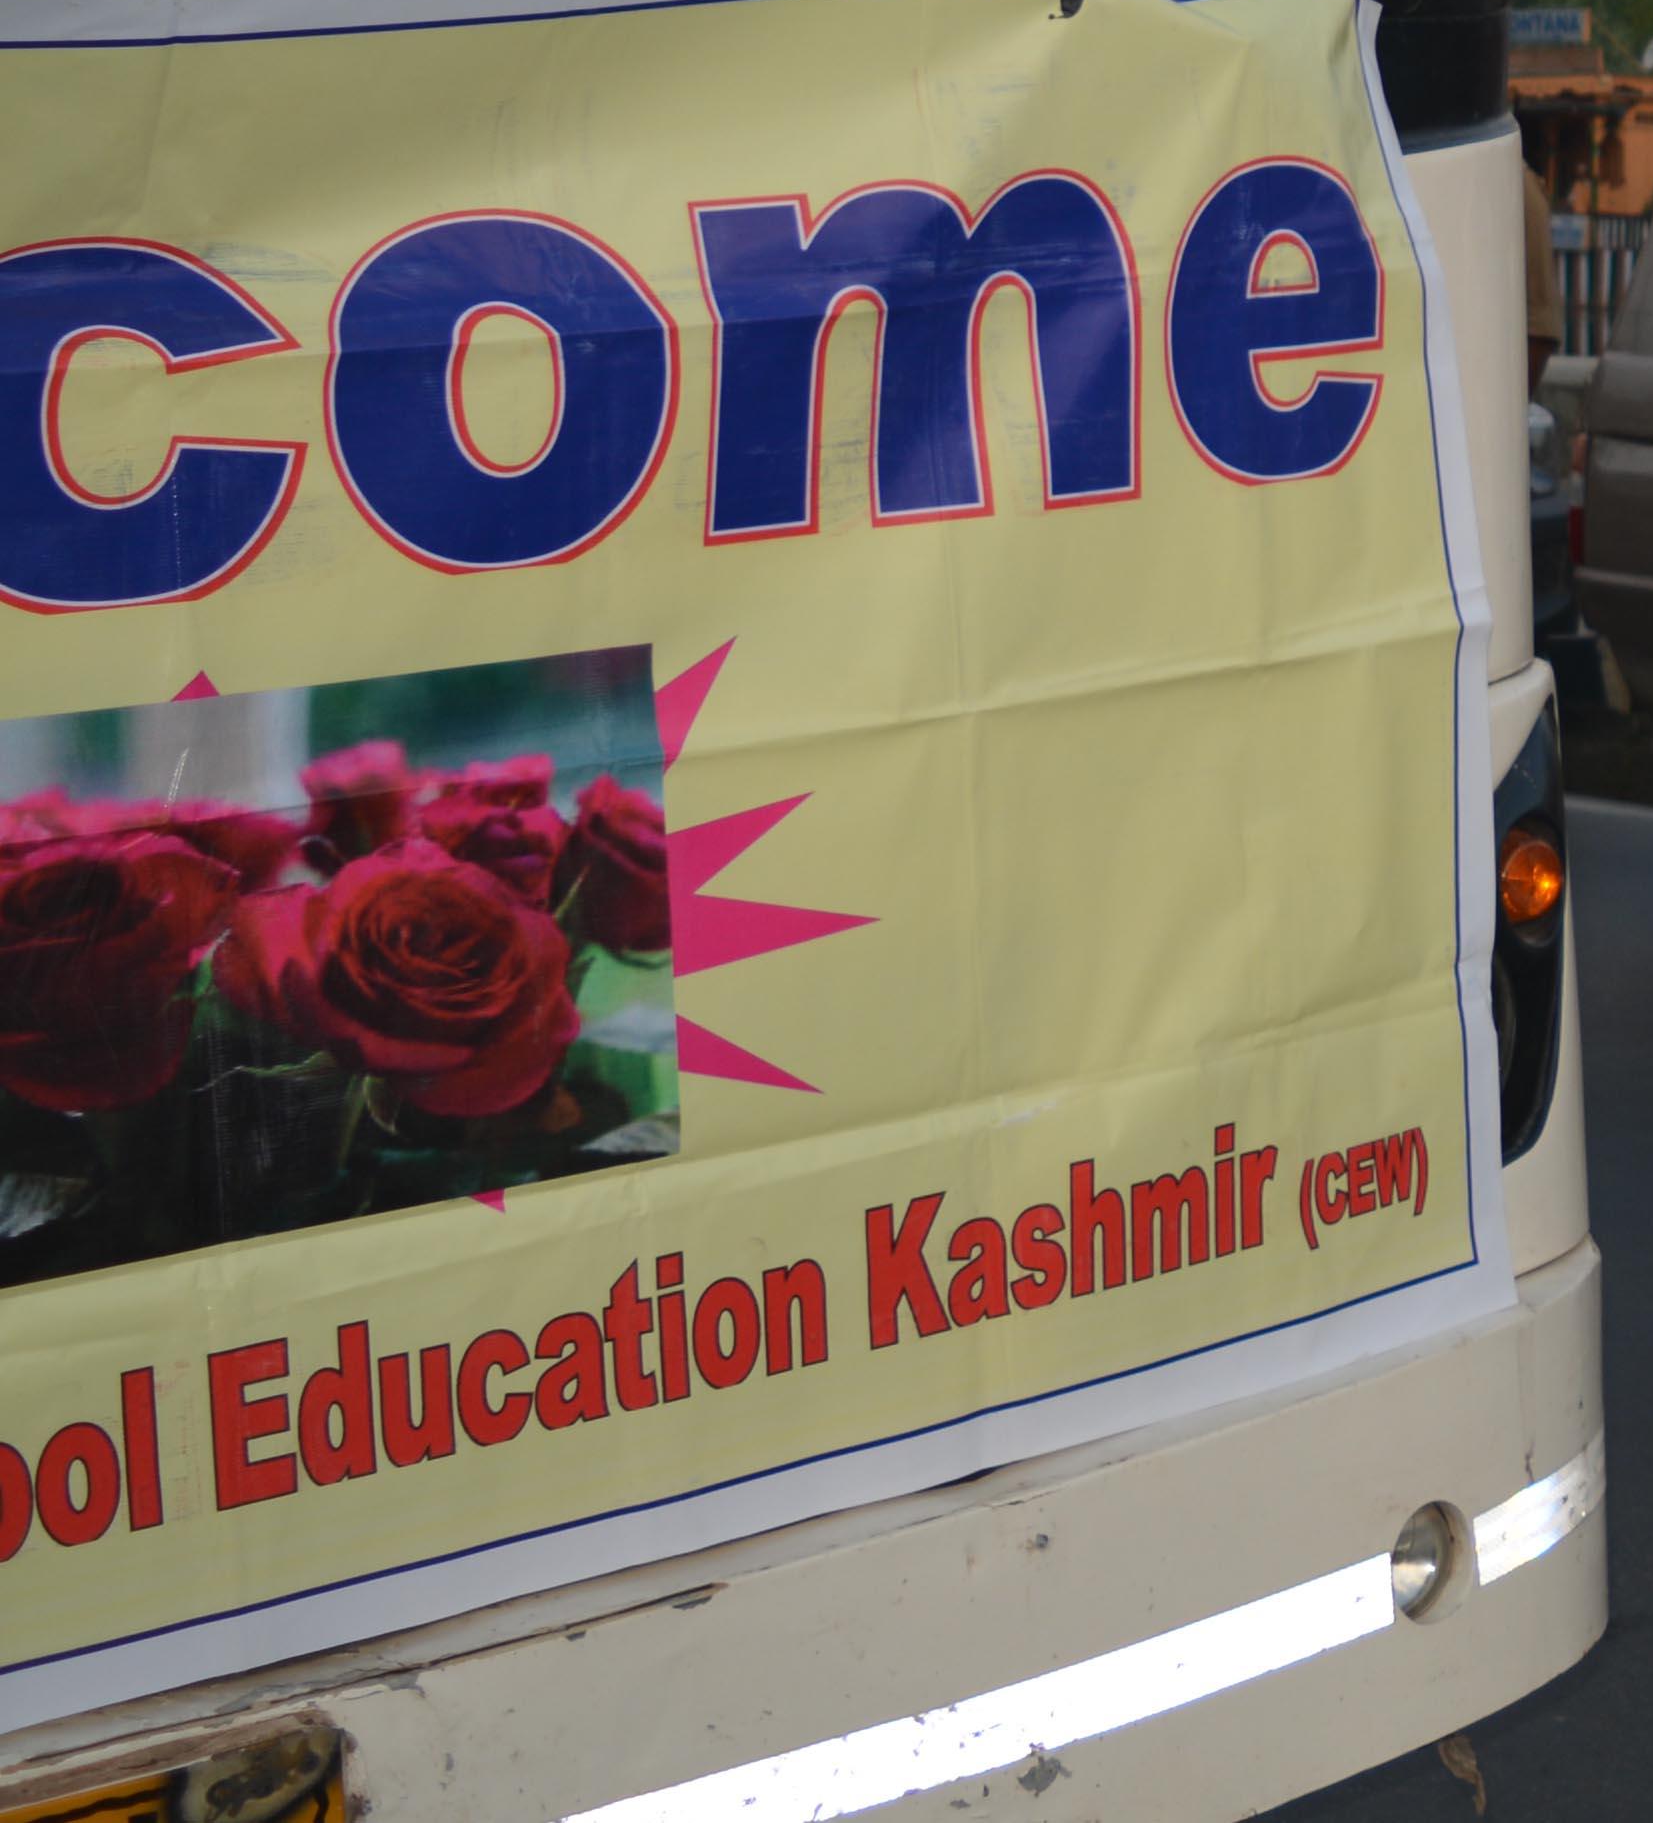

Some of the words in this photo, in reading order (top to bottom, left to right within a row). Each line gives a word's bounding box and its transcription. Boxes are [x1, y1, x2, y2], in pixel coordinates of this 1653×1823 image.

[0, 155, 1385, 616] come
[207, 1250, 828, 1511] Education
[866, 1122, 1278, 1351] Kashmir
[1297, 1125, 1429, 1251] (CEW)
